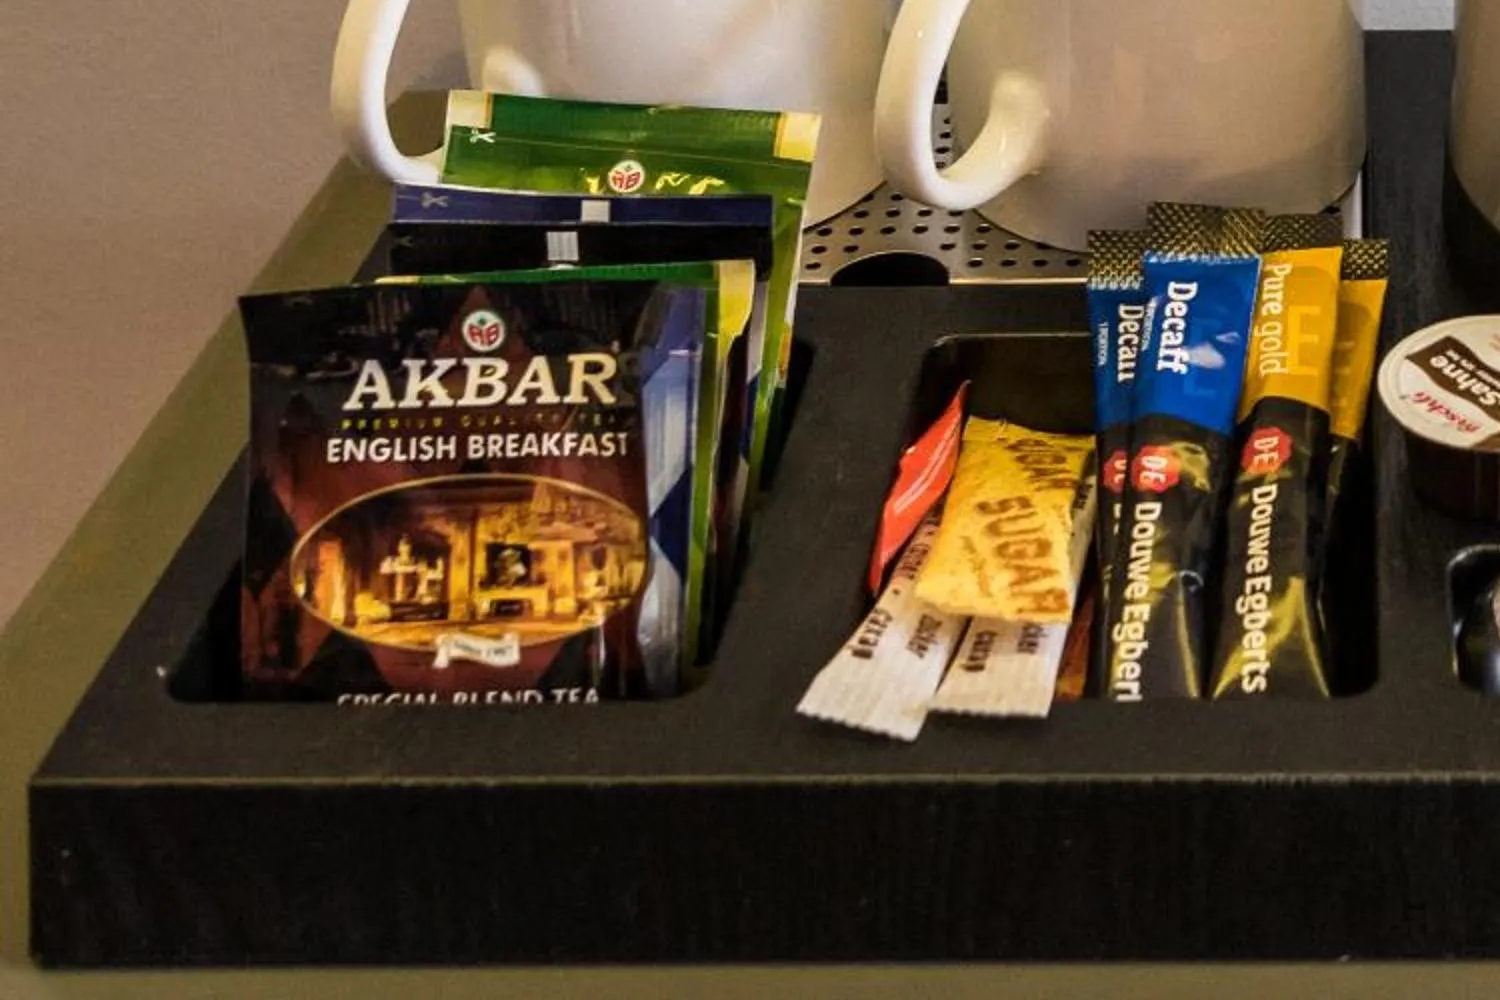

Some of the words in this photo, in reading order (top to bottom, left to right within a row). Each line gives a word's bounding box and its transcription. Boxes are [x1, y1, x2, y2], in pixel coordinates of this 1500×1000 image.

[1157, 281, 1198, 375] Decaff
[1261, 263, 1292, 316] Pure
[342, 352, 618, 411] AKBAR
[1254, 321, 1289, 378] gold
[327, 435, 457, 463] ENGLISH
[467, 432, 628, 459] BREAKFAST
[976, 496, 1069, 614] SUGAR
[1124, 501, 1163, 599] Douwe
[1246, 483, 1279, 574] Douwe
[1235, 575, 1274, 693] Egberts
